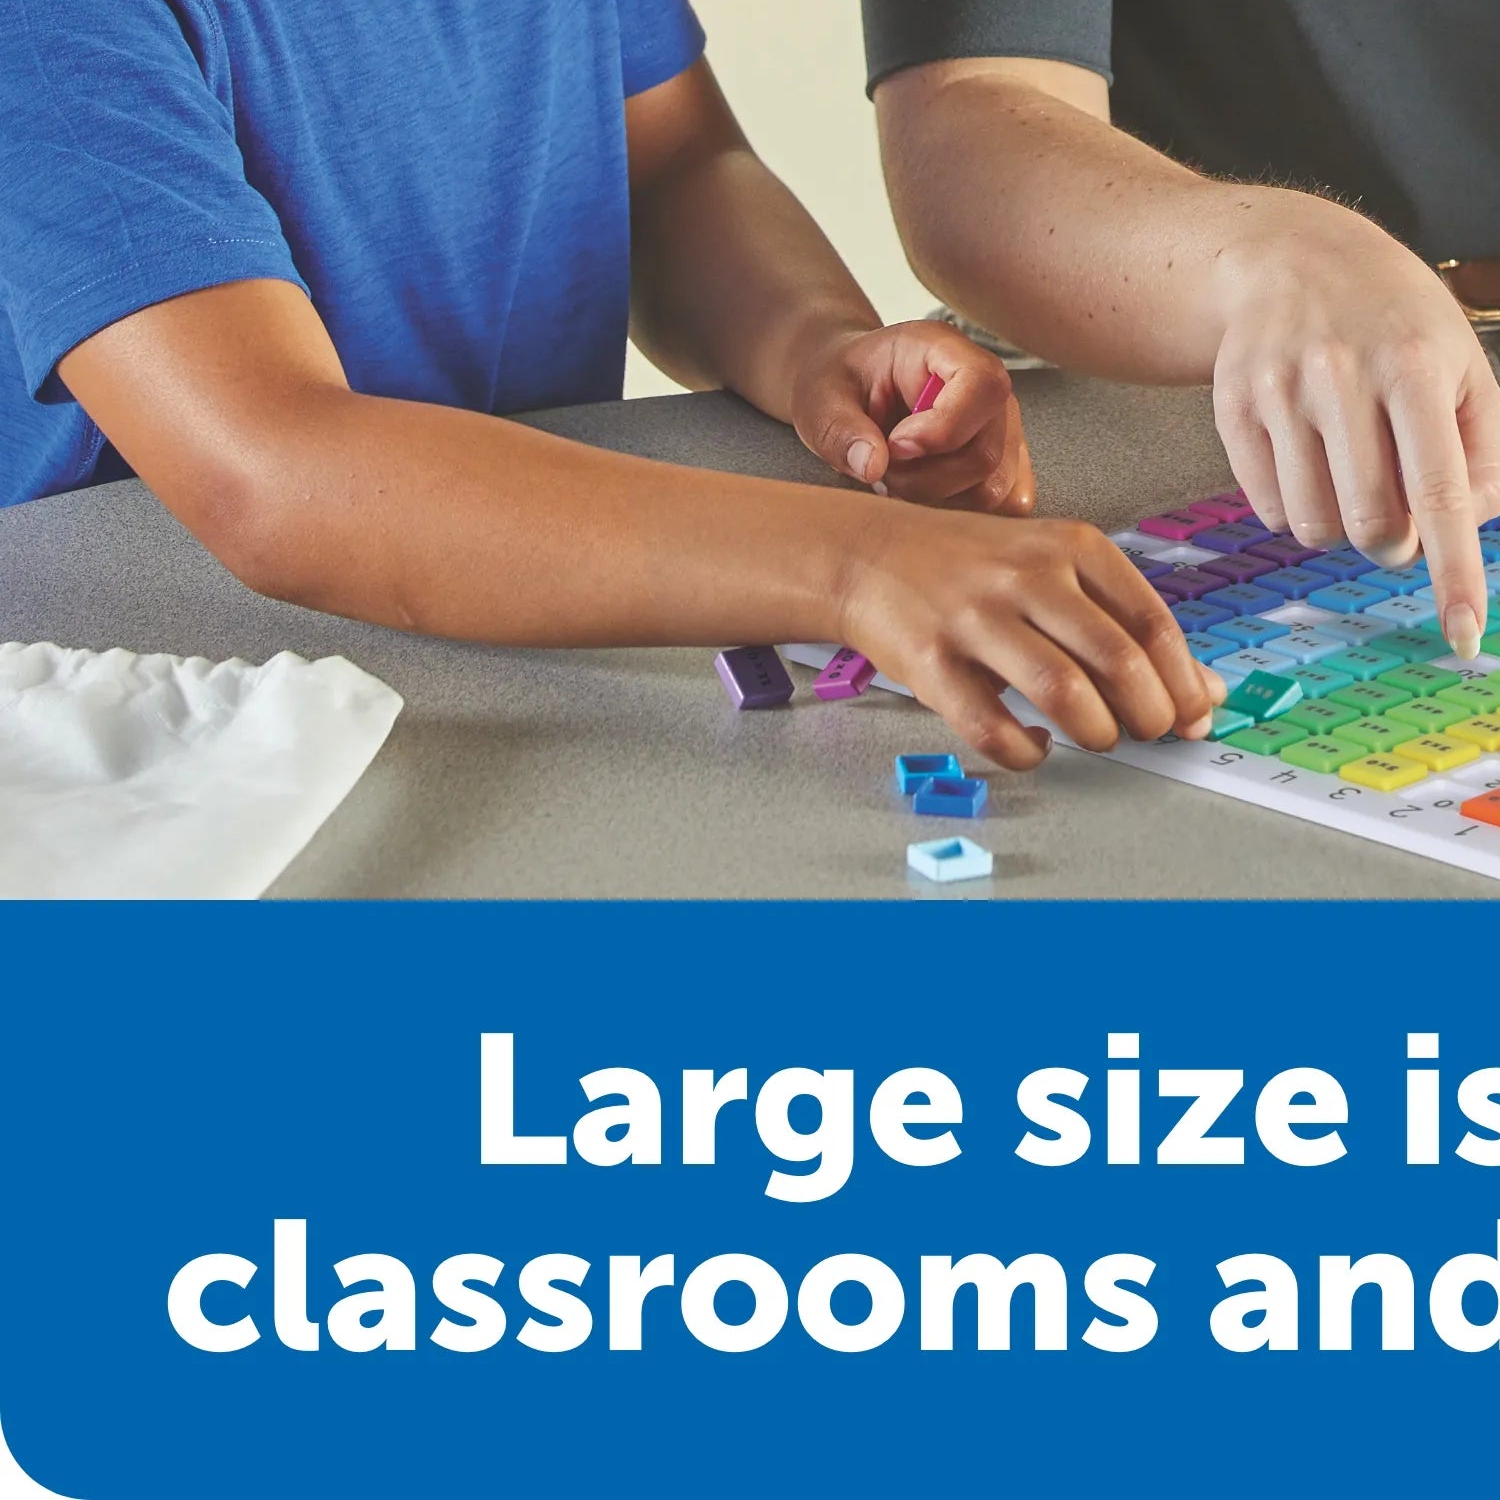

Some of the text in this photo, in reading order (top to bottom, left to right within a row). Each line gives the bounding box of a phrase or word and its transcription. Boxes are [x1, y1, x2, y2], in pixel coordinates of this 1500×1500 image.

[1211, 753, 1243, 765] 5
[1271, 770, 1297, 783] 4
[1329, 788, 1361, 799] 3
[1389, 805, 1423, 817] 2
[1455, 826, 1479, 835] 1
